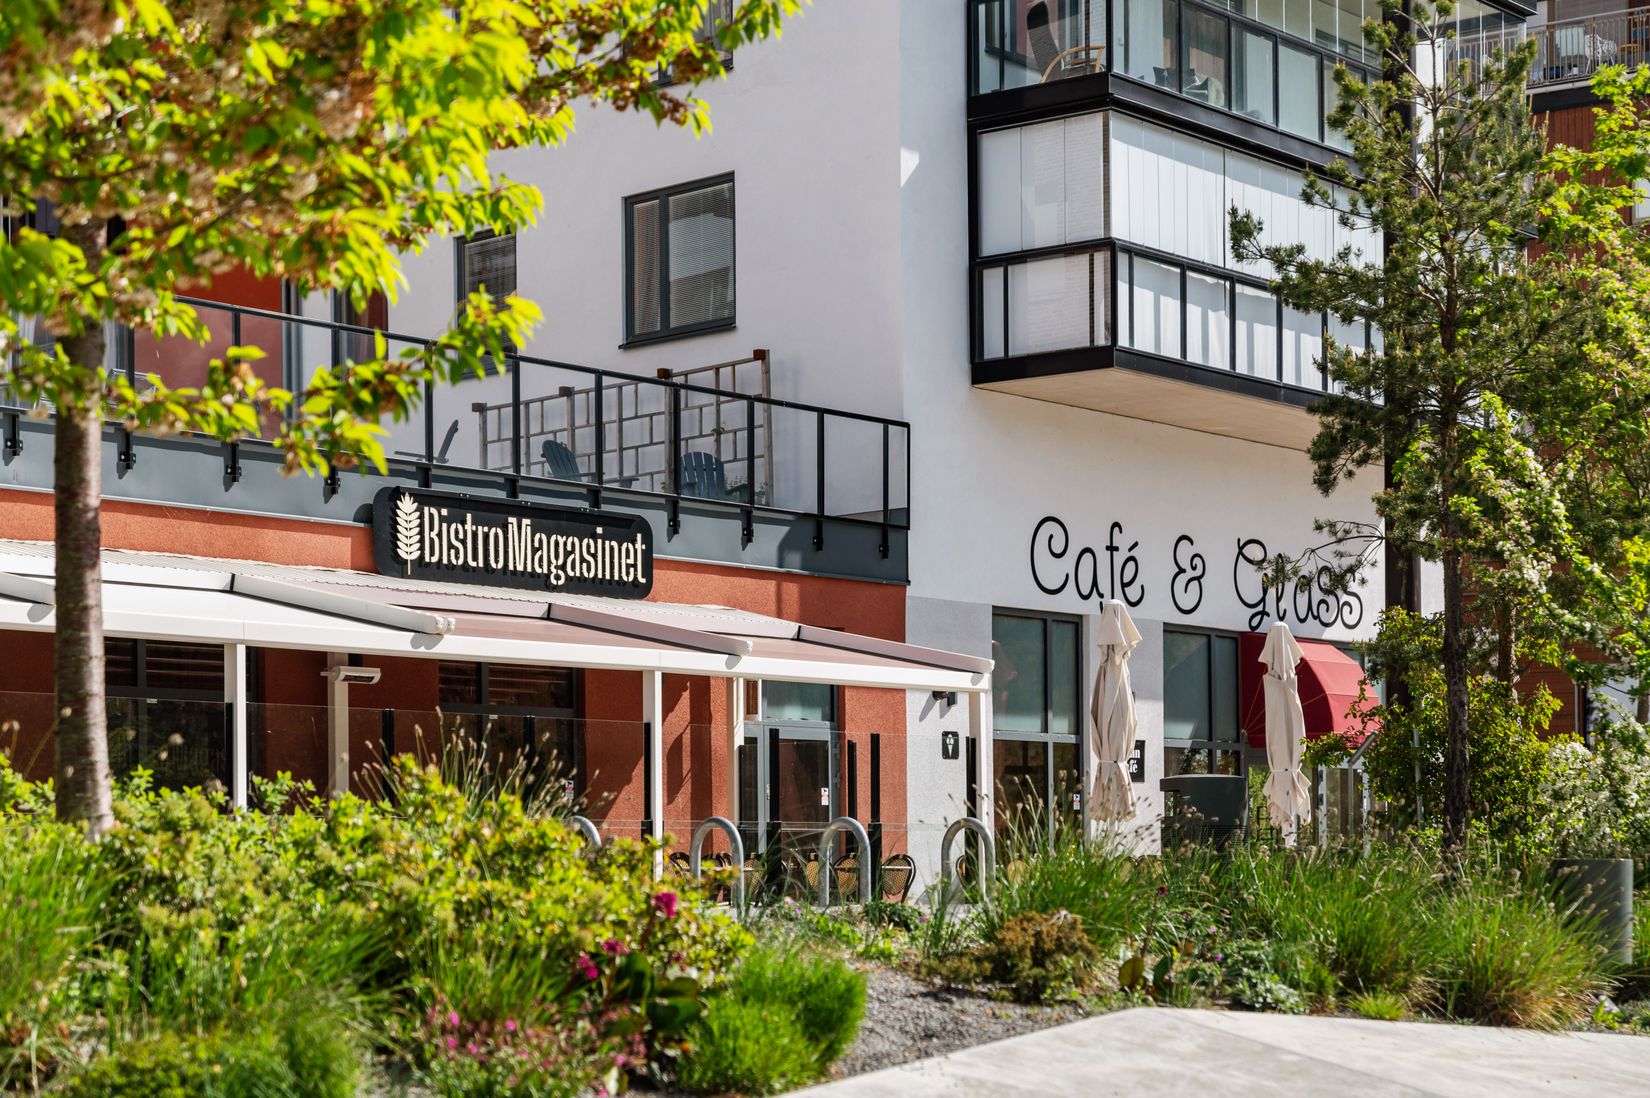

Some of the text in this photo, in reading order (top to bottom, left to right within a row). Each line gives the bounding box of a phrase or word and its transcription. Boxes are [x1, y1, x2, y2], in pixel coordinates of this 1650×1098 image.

[423, 505, 647, 586] BistroMagasinet
[1030, 515, 1364, 632] Café & Glass
